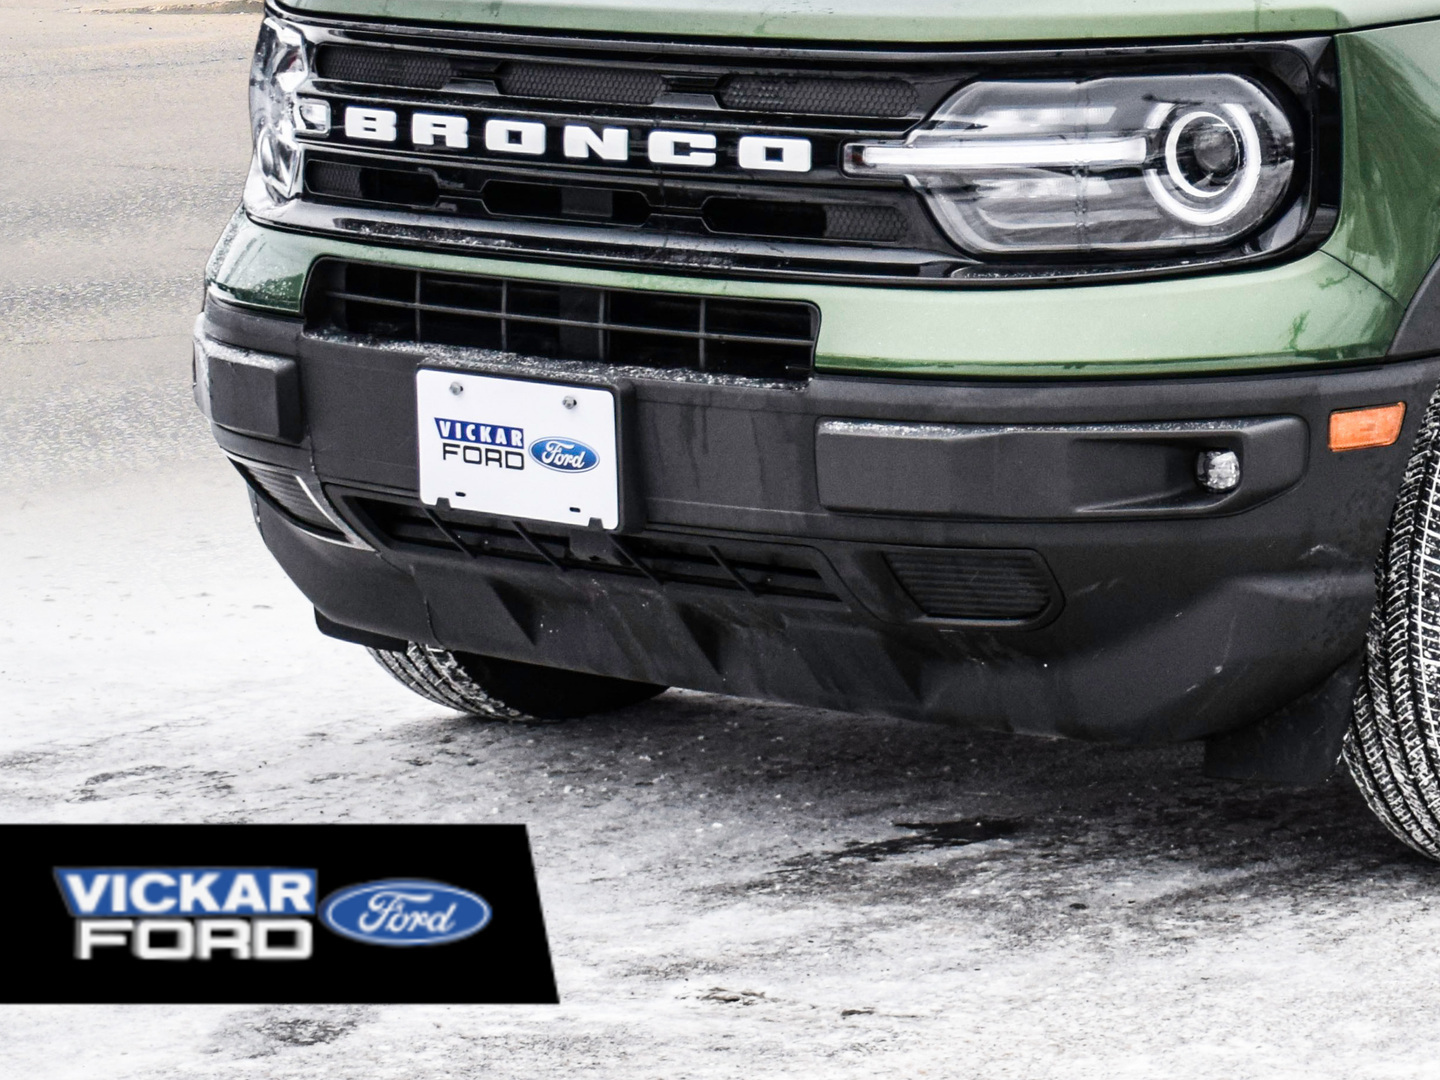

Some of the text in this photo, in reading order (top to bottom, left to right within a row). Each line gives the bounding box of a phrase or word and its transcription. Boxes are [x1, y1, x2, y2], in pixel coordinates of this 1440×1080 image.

[344, 107, 811, 173] BRONCO
[438, 419, 524, 448] VICKAR
[442, 442, 525, 471] FORD
[542, 441, 586, 469] Ford
